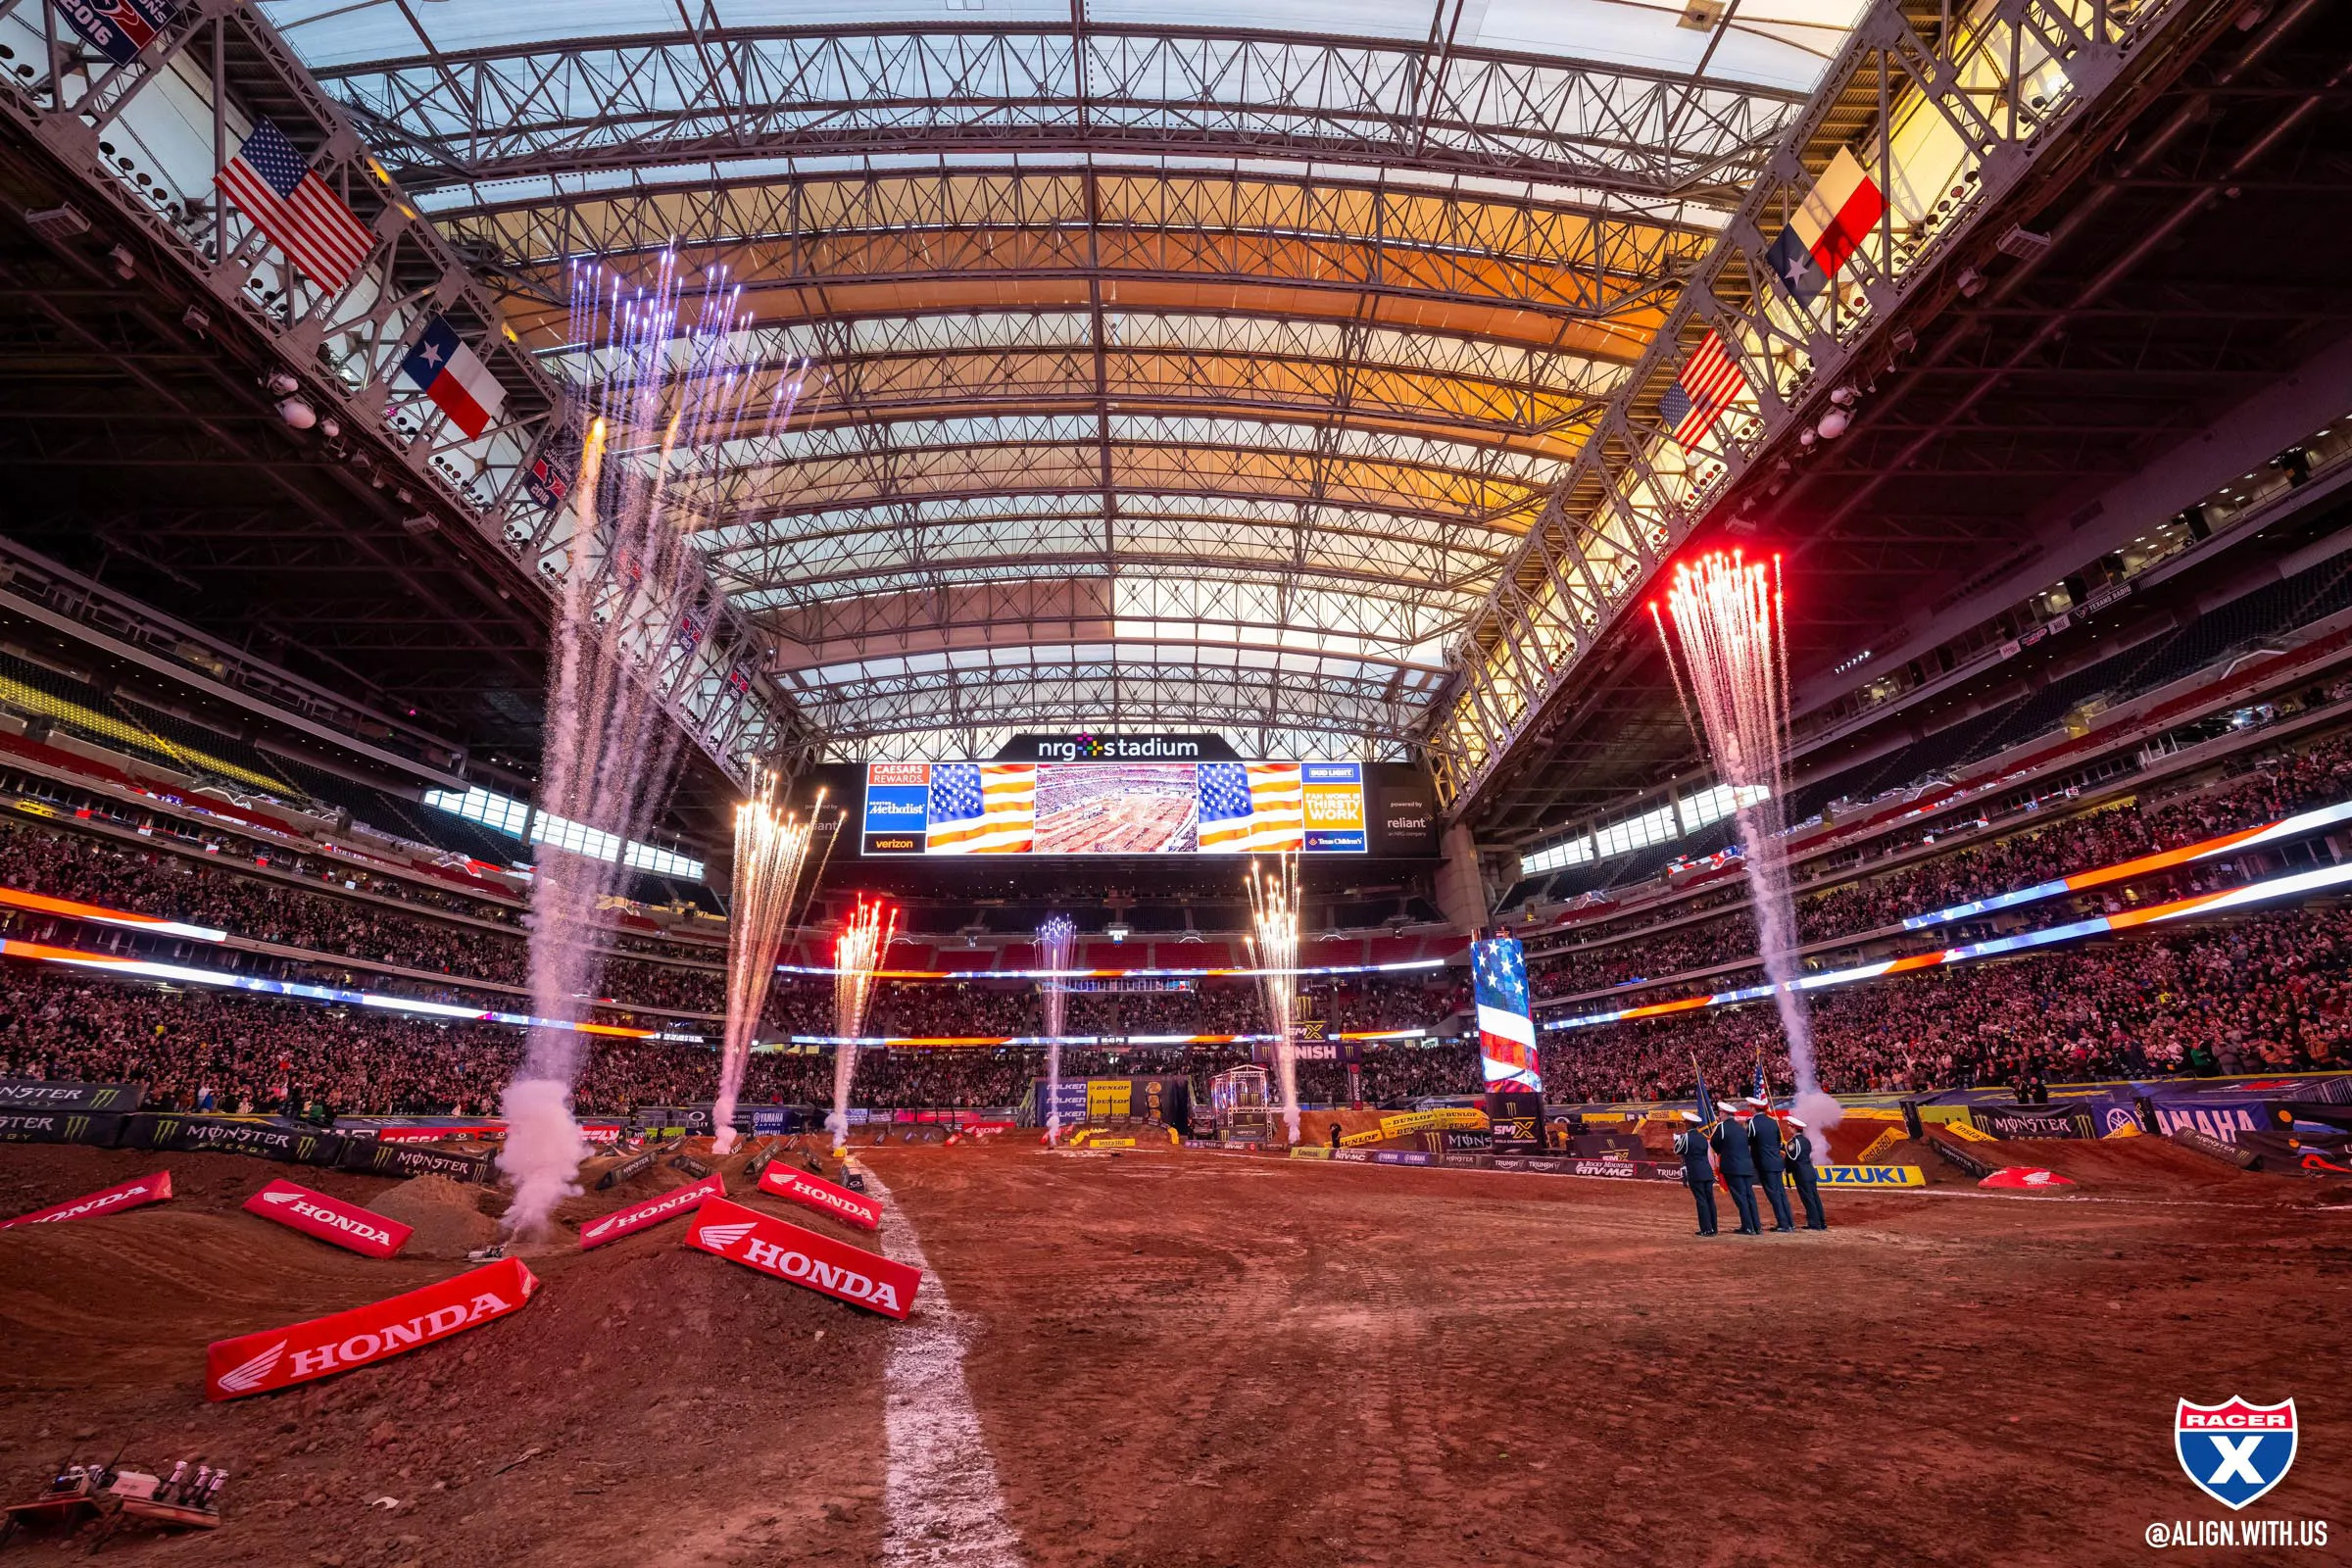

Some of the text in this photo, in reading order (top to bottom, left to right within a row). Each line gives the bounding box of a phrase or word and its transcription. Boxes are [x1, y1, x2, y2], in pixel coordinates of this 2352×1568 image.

[530, 482, 550, 505] 2018
[2089, 586, 2132, 611] TEXANS RADIO
[1039, 737, 1198, 761] nrg stadium
[874, 765, 923, 774] CAESARS
[868, 803, 923, 814] Methodist
[1305, 800, 1361, 809] THIRSTY
[1309, 809, 1358, 820] WORK
[1387, 817, 1427, 828] reliant
[875, 839, 913, 849] verizon
[0, 1085, 82, 1100] NSTER
[760, 1112, 784, 1123] YAMAHA
[1393, 1113, 1434, 1125] DUNLOP
[1994, 1115, 2072, 1134] MONSTER
[2155, 1109, 2257, 1144] AMAHA
[185, 1124, 290, 1148] MONSTER
[1494, 1121, 1535, 1139] SMX
[198, 1143, 270, 1154] ENERGY
[1448, 1133, 1493, 1148] MONS
[1862, 1135, 1891, 1161] Insta360
[2194, 1134, 2235, 1153] MONSTER
[397, 1152, 468, 1174] MONSTER
[1602, 1161, 1635, 1170] MOUNTAIN
[1941, 1147, 1973, 1168] MONSTER
[1657, 1168, 1683, 1180] TRIUM
[1815, 1166, 1908, 1183] UZUKI
[614, 1184, 716, 1228] HONDA
[792, 1181, 874, 1221] HONDA
[290, 1201, 391, 1247] HONDA
[743, 1237, 901, 1311] HONDA
[289, 1292, 512, 1378] HONDA
